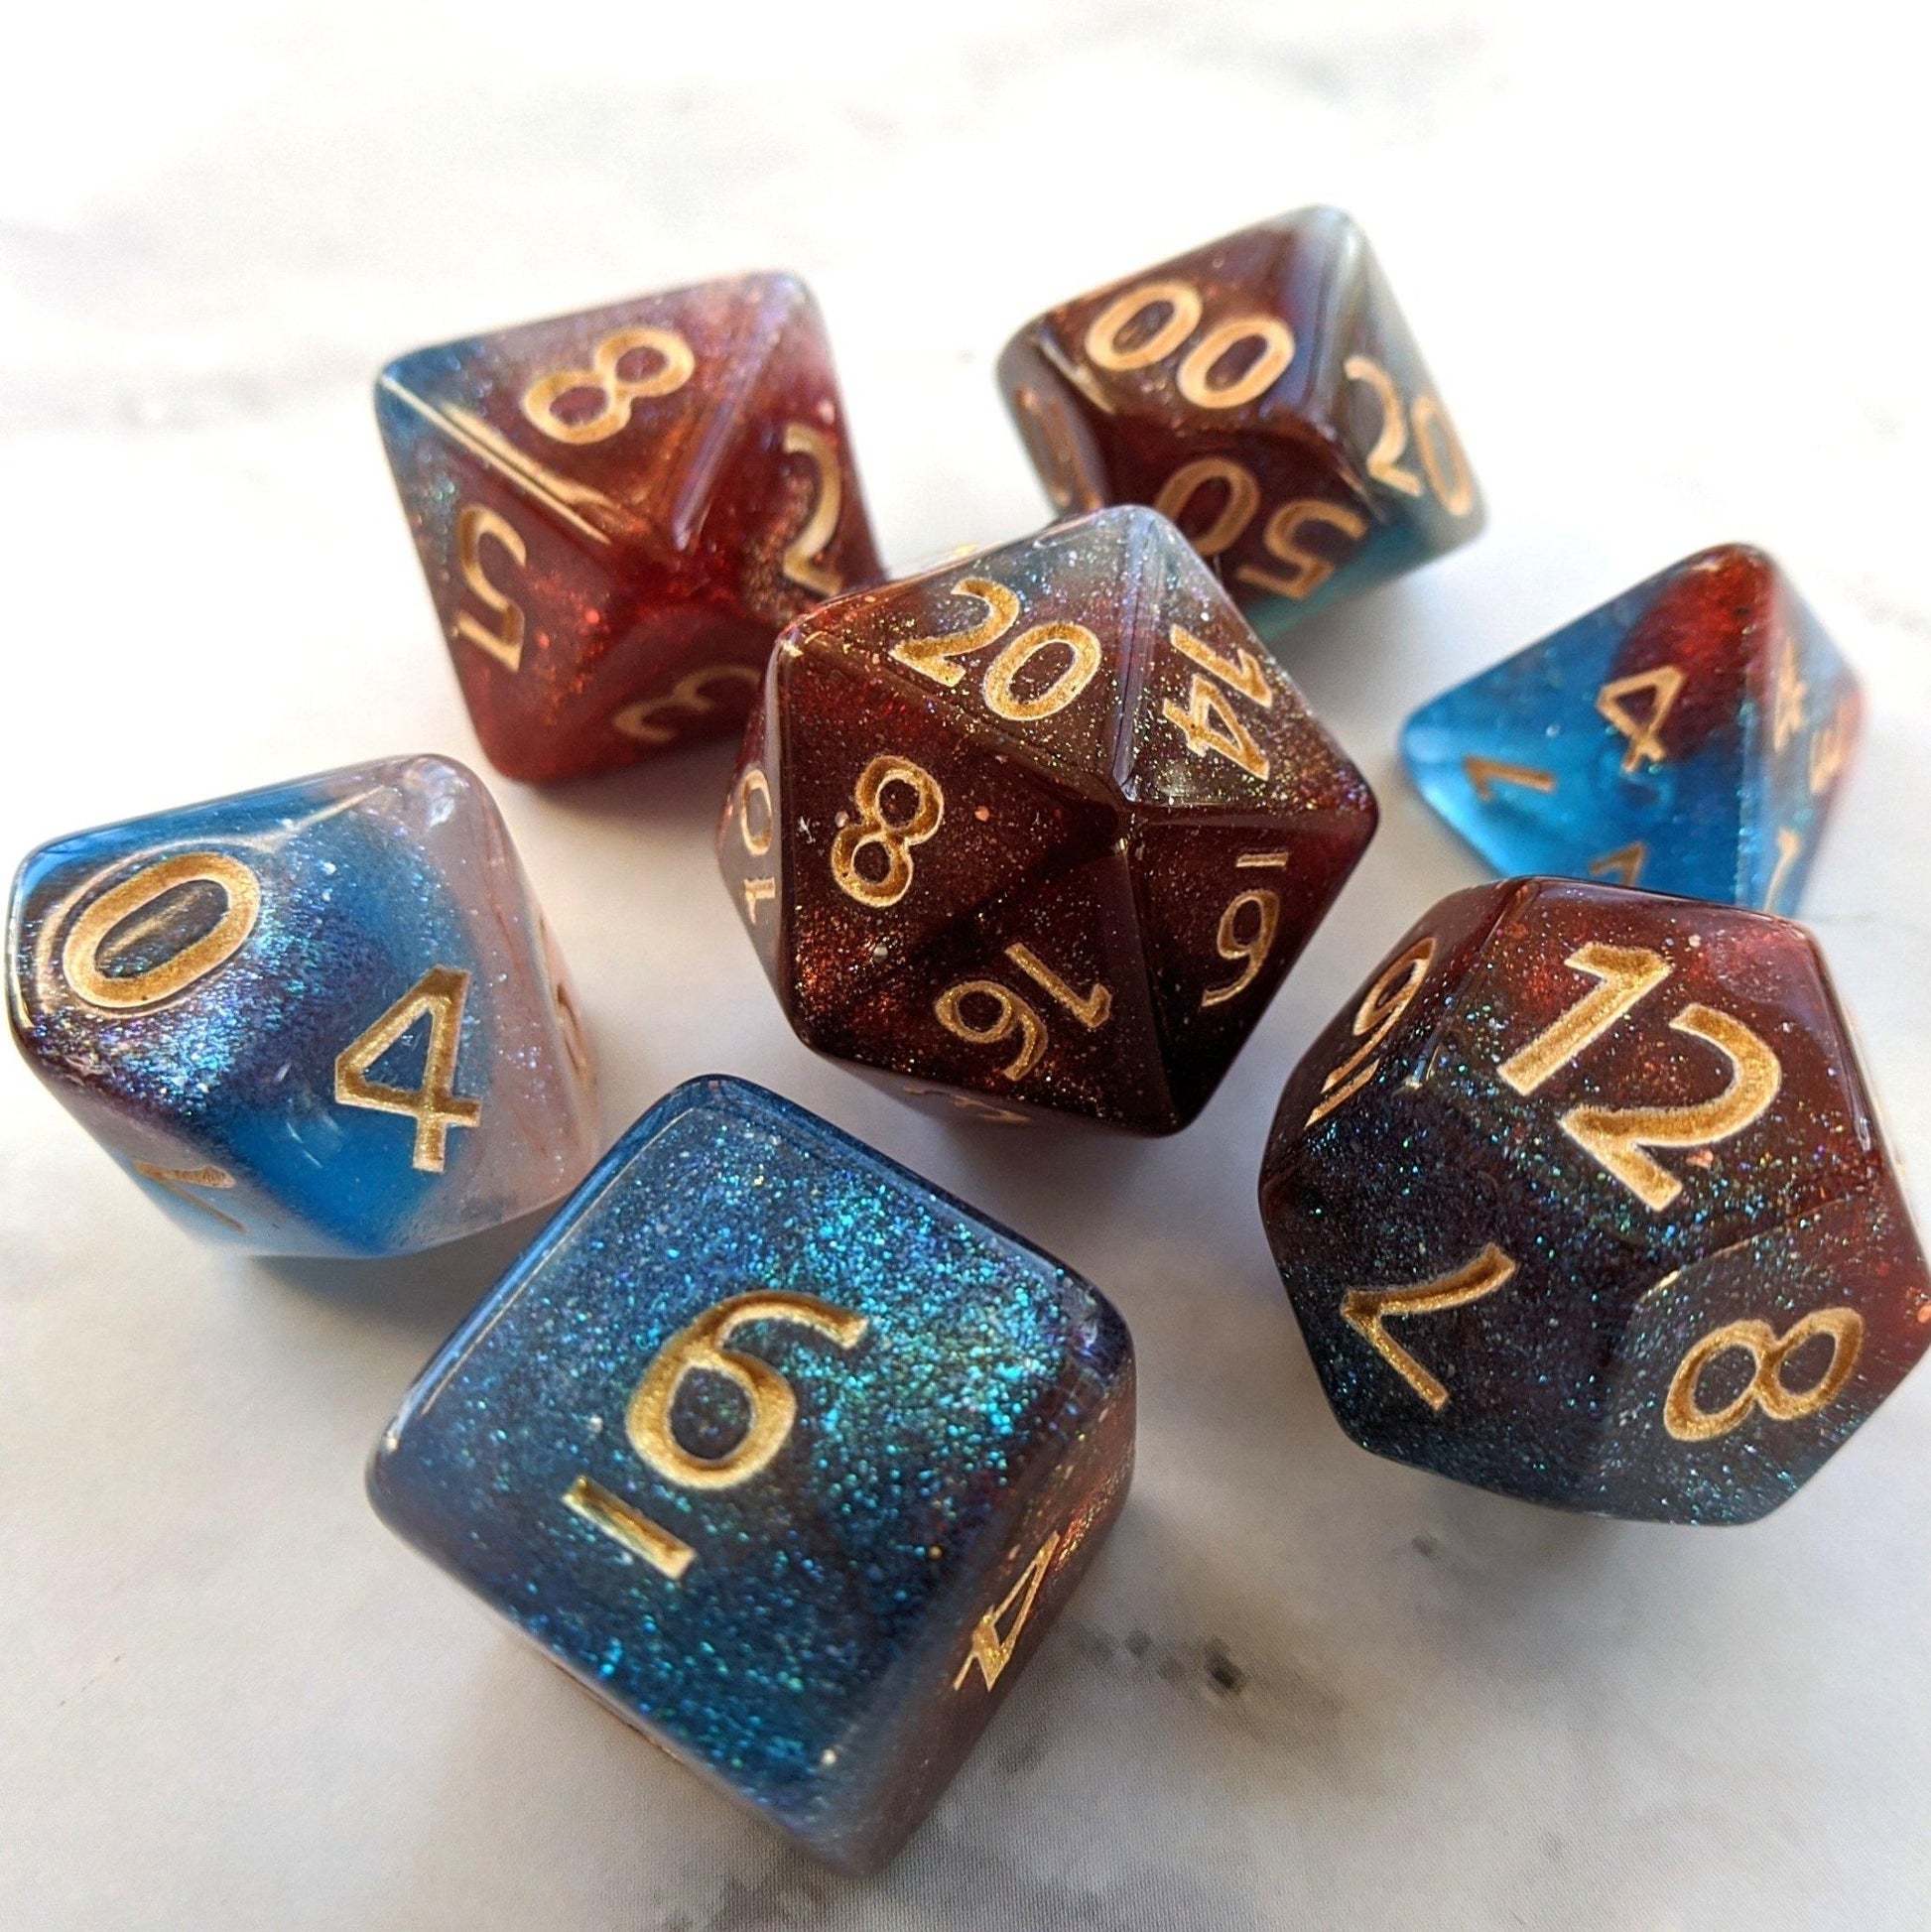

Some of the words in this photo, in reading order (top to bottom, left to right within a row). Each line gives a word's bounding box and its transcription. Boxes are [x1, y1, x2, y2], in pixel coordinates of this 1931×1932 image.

[523, 326, 696, 445] 8
[1085, 281, 1296, 409] 00
[783, 423, 843, 595] 2
[1344, 355, 1473, 517] 20
[457, 505, 527, 673] 5
[889, 577, 1102, 721] 20
[1163, 624, 1273, 782] 14
[1596, 666, 1686, 774] 4
[831, 755, 944, 908] 8
[63, 851, 261, 1010] 0
[1201, 889, 1280, 1008] 6
[333, 964, 482, 1173] 4
[934, 942, 1113, 1083] 16
[1496, 942, 1782, 1214] 12
[623, 1288, 869, 1491] 6
[1342, 1242, 1517, 1412] 7
[1664, 1307, 1864, 1442] 8
[954, 1530, 1061, 1692] 4
